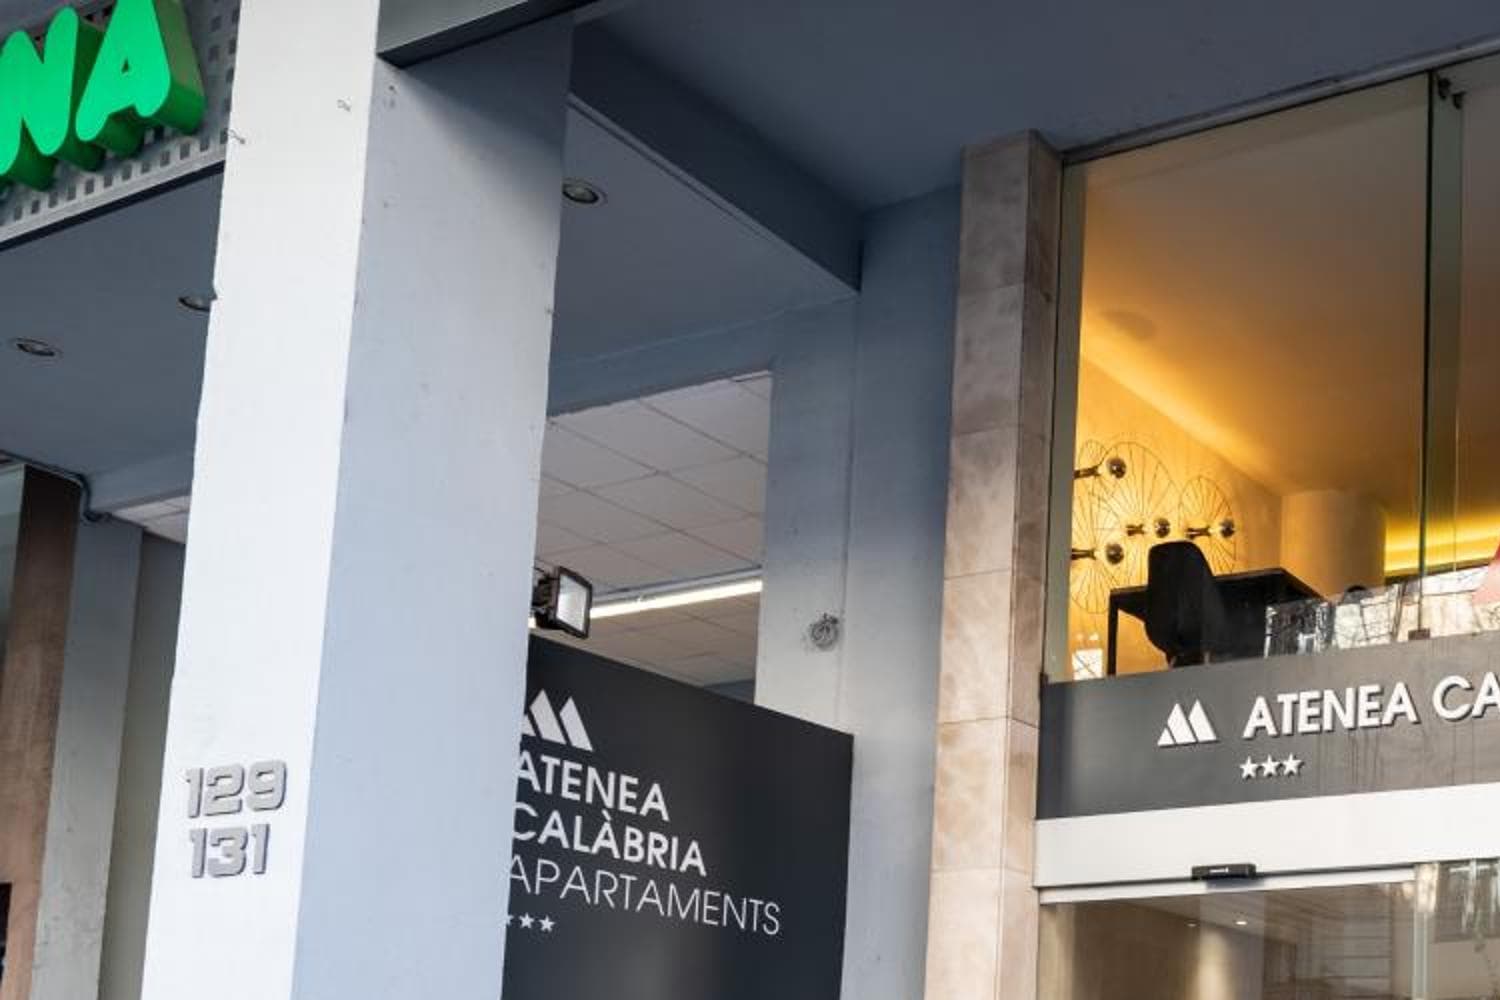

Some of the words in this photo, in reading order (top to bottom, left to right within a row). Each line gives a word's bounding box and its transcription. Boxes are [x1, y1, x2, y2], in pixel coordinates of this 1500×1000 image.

[1242, 680, 1421, 741] ATENEA
[185, 759, 289, 819] 129
[515, 749, 671, 823] ATENEA
[189, 822, 271, 880] 131
[512, 800, 708, 877] CALÀBRIA
[509, 853, 782, 937] APARTAMENTS
